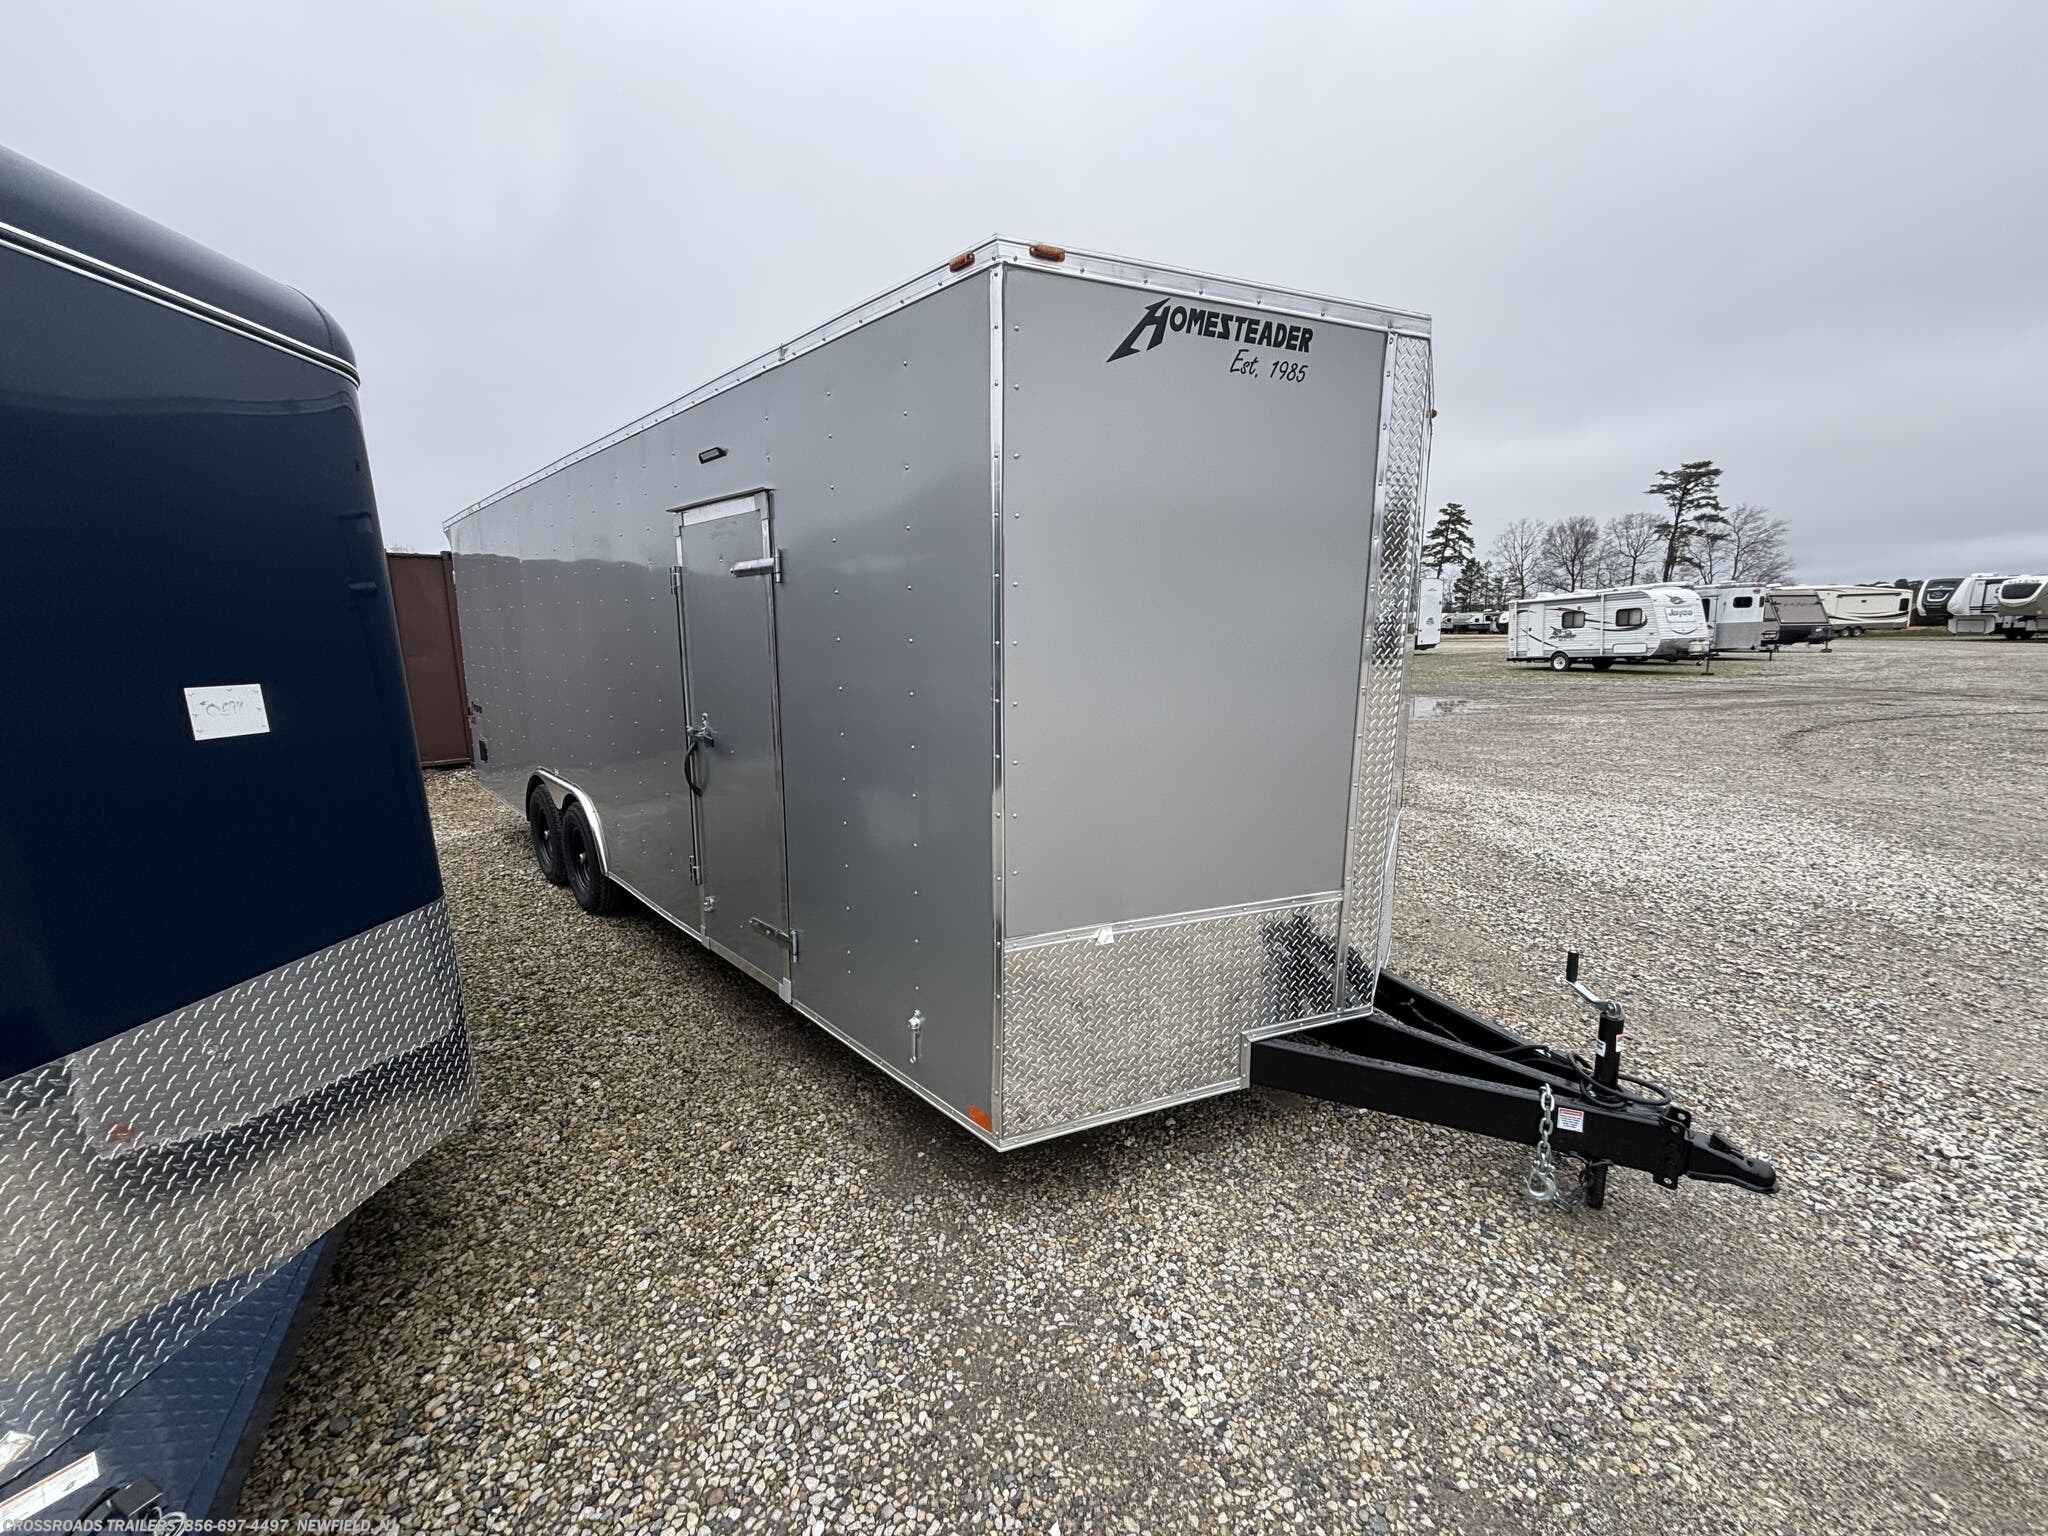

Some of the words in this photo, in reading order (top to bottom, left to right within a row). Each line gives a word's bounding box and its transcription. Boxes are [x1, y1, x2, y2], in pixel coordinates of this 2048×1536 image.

[1106, 298, 1313, 362] HOMESTEADER
[1270, 361, 1308, 382] 1985
[1668, 609, 1693, 618] Jayco
